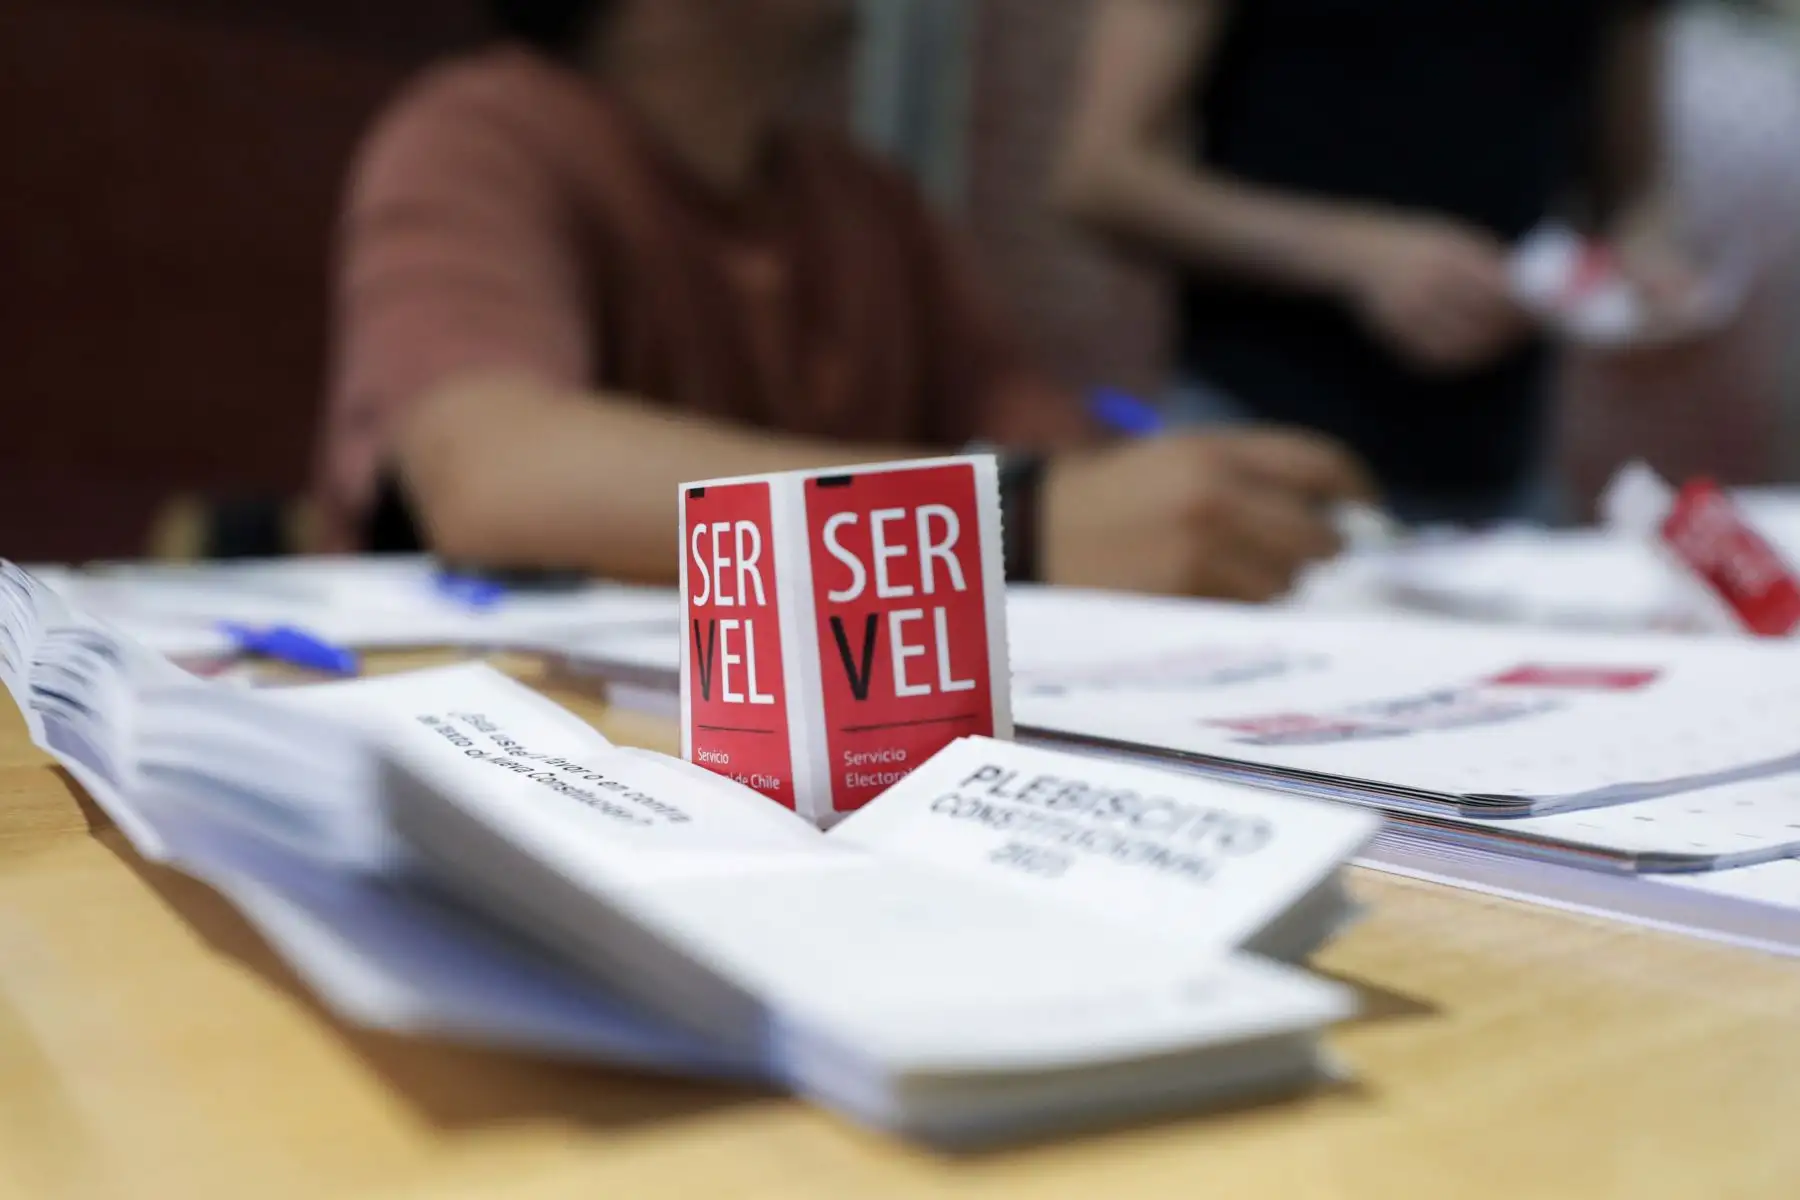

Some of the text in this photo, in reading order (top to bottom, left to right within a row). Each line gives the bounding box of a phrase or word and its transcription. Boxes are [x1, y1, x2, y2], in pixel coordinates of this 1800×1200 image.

[691, 519, 767, 607] SER
[822, 503, 968, 603] SER
[693, 618, 775, 705] VEL
[828, 605, 977, 702] VEL
[697, 746, 730, 764] Servicio
[750, 773, 780, 789] Chile
[844, 747, 907, 766] Servicio
[845, 767, 913, 788] Elector
